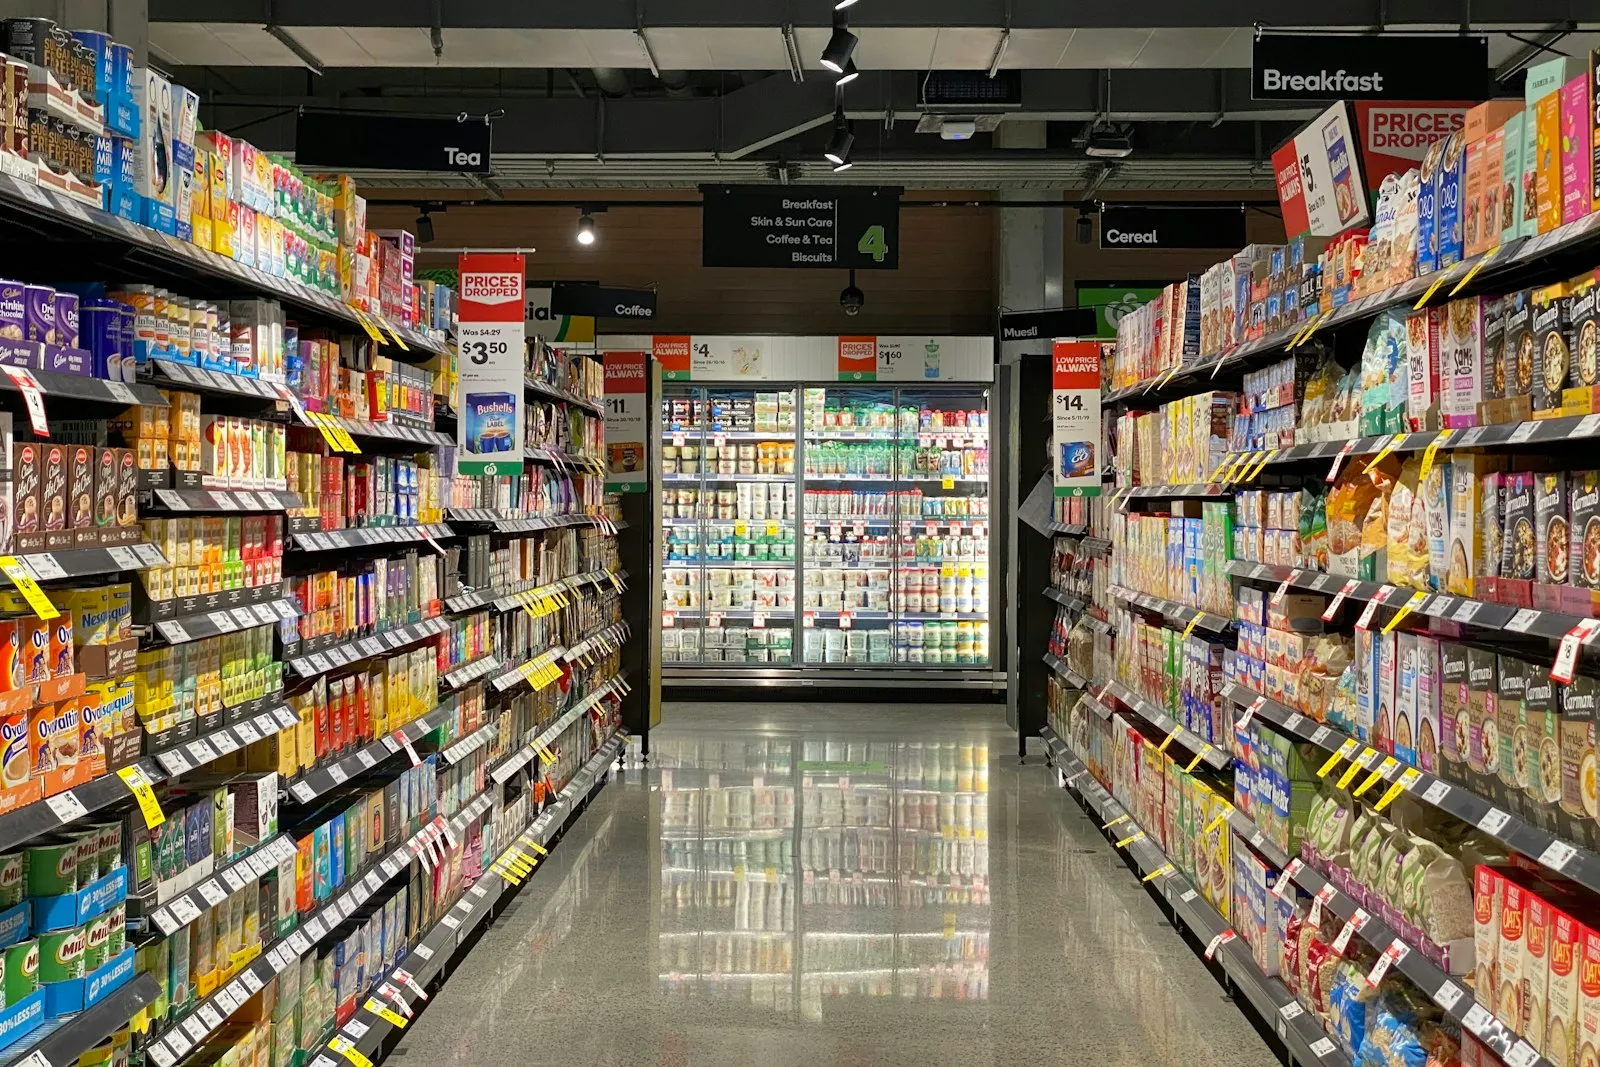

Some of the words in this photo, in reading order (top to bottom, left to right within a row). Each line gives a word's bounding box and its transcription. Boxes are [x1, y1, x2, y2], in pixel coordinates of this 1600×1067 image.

[1263, 69, 1384, 92] Breakfast
[1373, 113, 1465, 132] PRICES
[1373, 133, 1450, 148] DROPP
[443, 147, 481, 166] Tea
[782, 199, 833, 210] Breakfast
[750, 216, 773, 227] Skin
[775, 216, 783, 227] &
[785, 216, 805, 227] Sun
[808, 217, 833, 228] Care
[766, 234, 801, 245] Coffee
[802, 234, 811, 245] &
[812, 235, 833, 245] Tea
[857, 225, 888, 262] 4
[1106, 228, 1158, 245] Cereal
[791, 252, 832, 263] Biscuits
[465, 275, 518, 288] PRICES
[464, 287, 519, 297] DROPPED
[614, 303, 653, 317] Coffee
[1003, 326, 1039, 339] Muesli
[655, 348, 689, 356] ALWAYS
[693, 343, 710, 358] $4
[605, 370, 645, 379] ALWAYS
[1055, 363, 1098, 373] ALWAYS
[477, 401, 513, 415] Bushells
[606, 398, 626, 414] $11
[1056, 394, 1084, 411] $14
[1476, 893, 1490, 913] OATS
[1503, 908, 1522, 929] OATS
[1529, 922, 1544, 943] OATS
[1552, 940, 1571, 963] OATS
[14, 1008, 30, 1025] LESS
